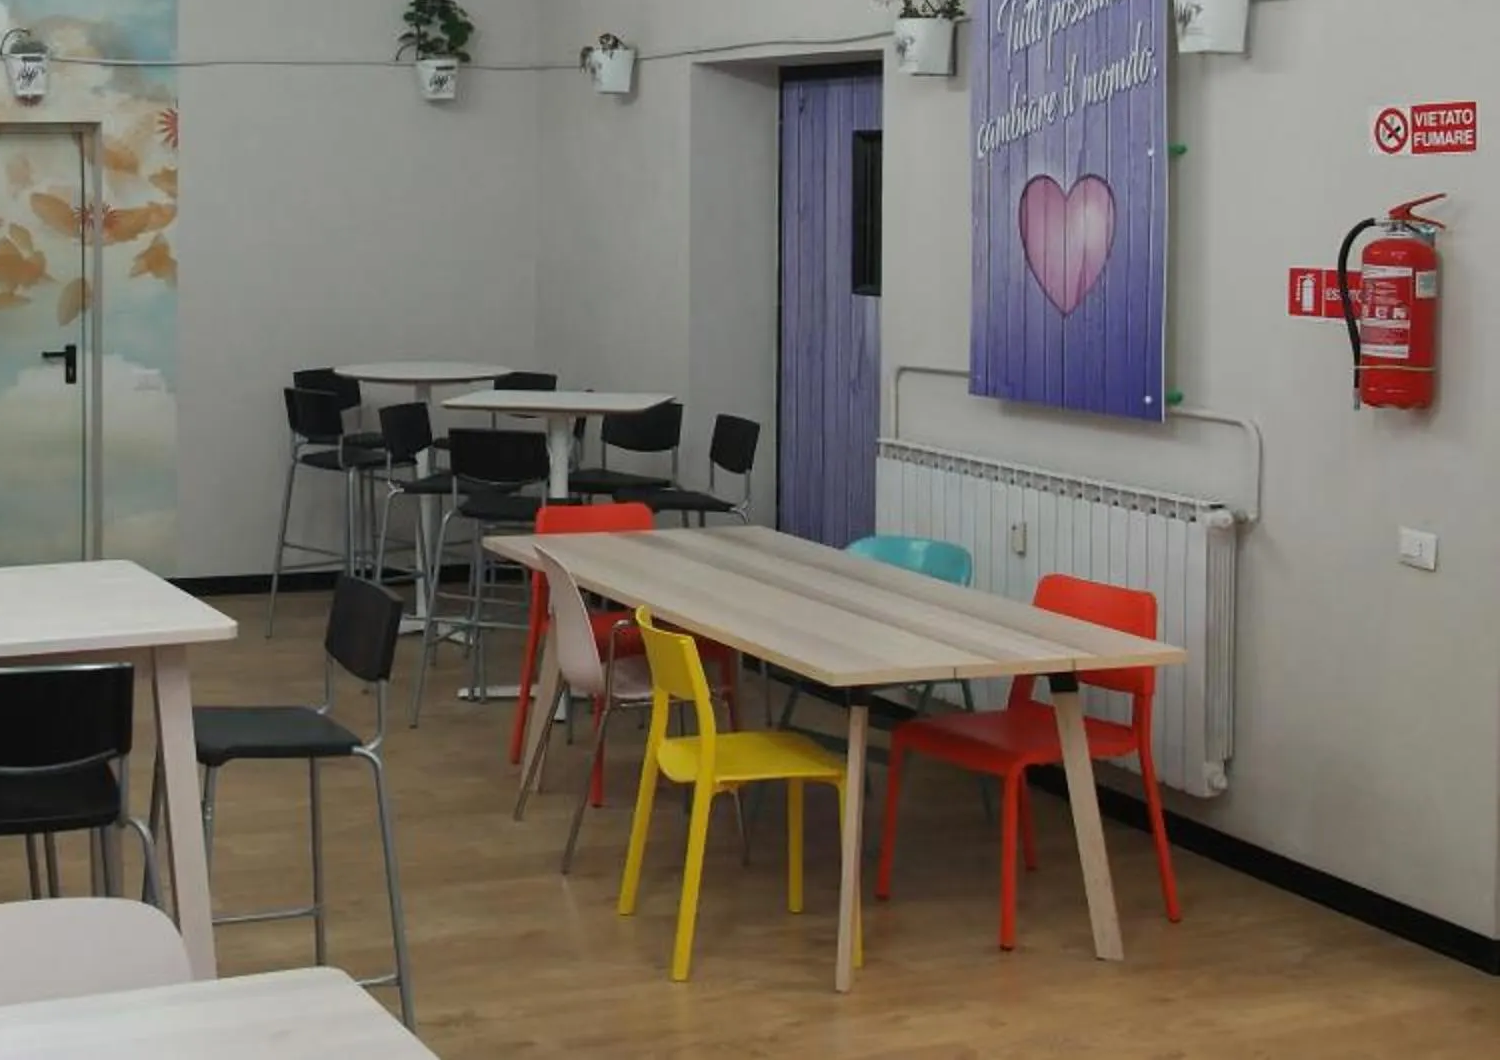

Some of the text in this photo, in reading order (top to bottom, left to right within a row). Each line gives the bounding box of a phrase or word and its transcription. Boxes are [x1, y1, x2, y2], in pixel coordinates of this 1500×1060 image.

[977, 82, 1059, 159] cambiare
[1063, 53, 1078, 118] il
[1414, 108, 1474, 127] VIETATO
[1413, 129, 1475, 147] FUMARE
